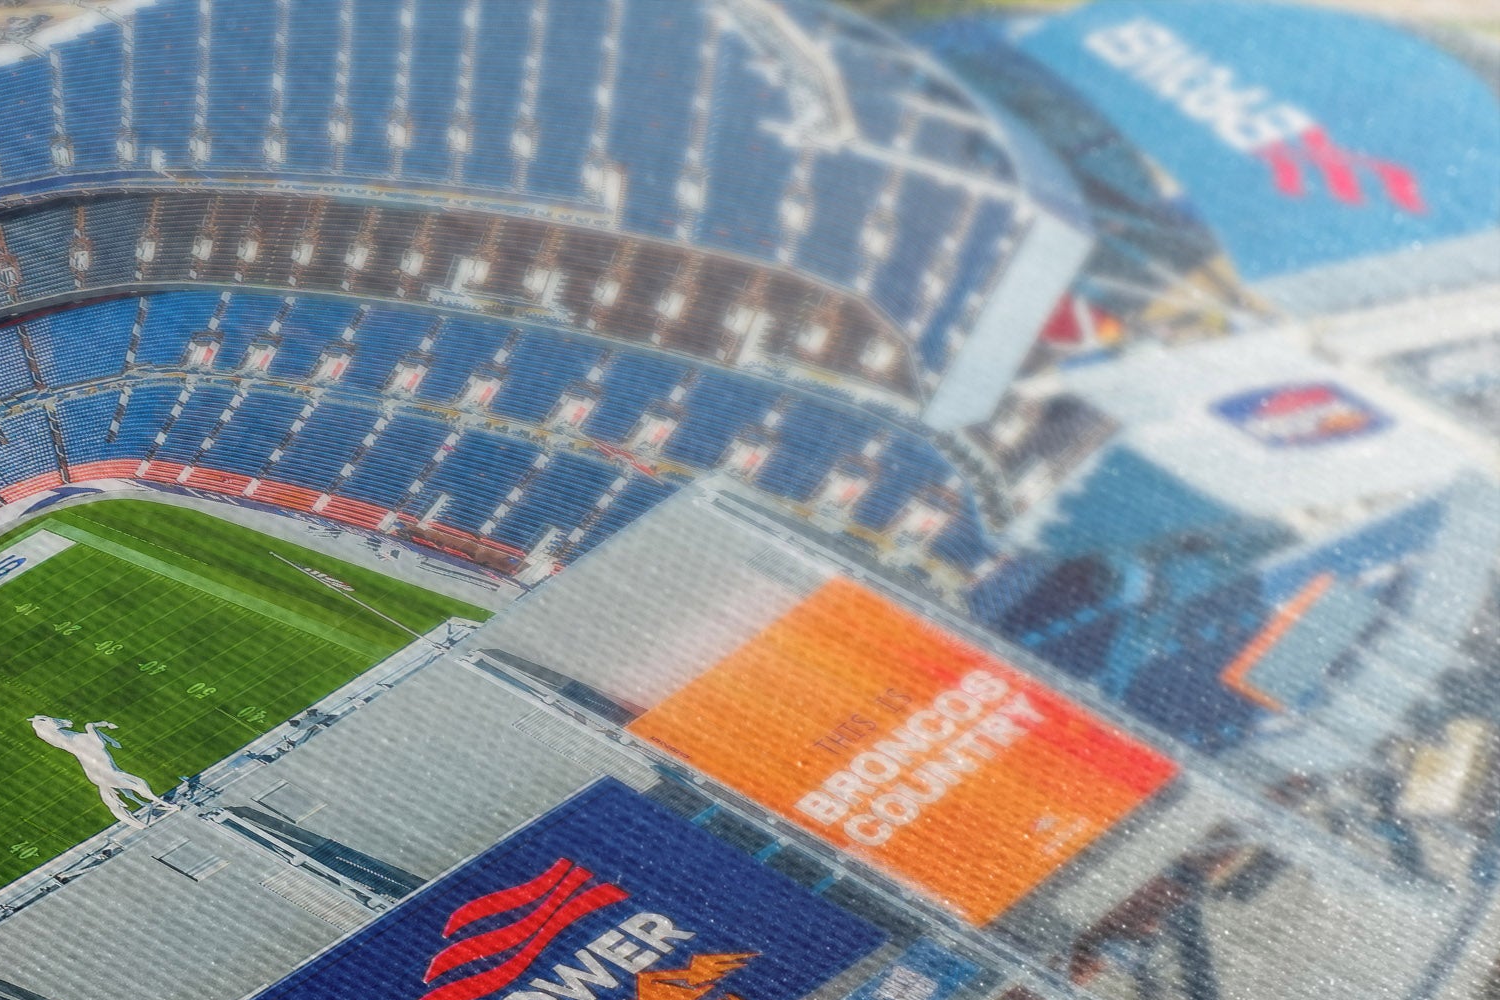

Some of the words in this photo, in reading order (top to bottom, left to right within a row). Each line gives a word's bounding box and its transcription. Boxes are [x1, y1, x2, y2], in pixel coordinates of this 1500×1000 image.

[793, 670, 1010, 826] BRONCOS
[843, 692, 1045, 847] COUNTRY
[10, 841, 37, 860] 40
